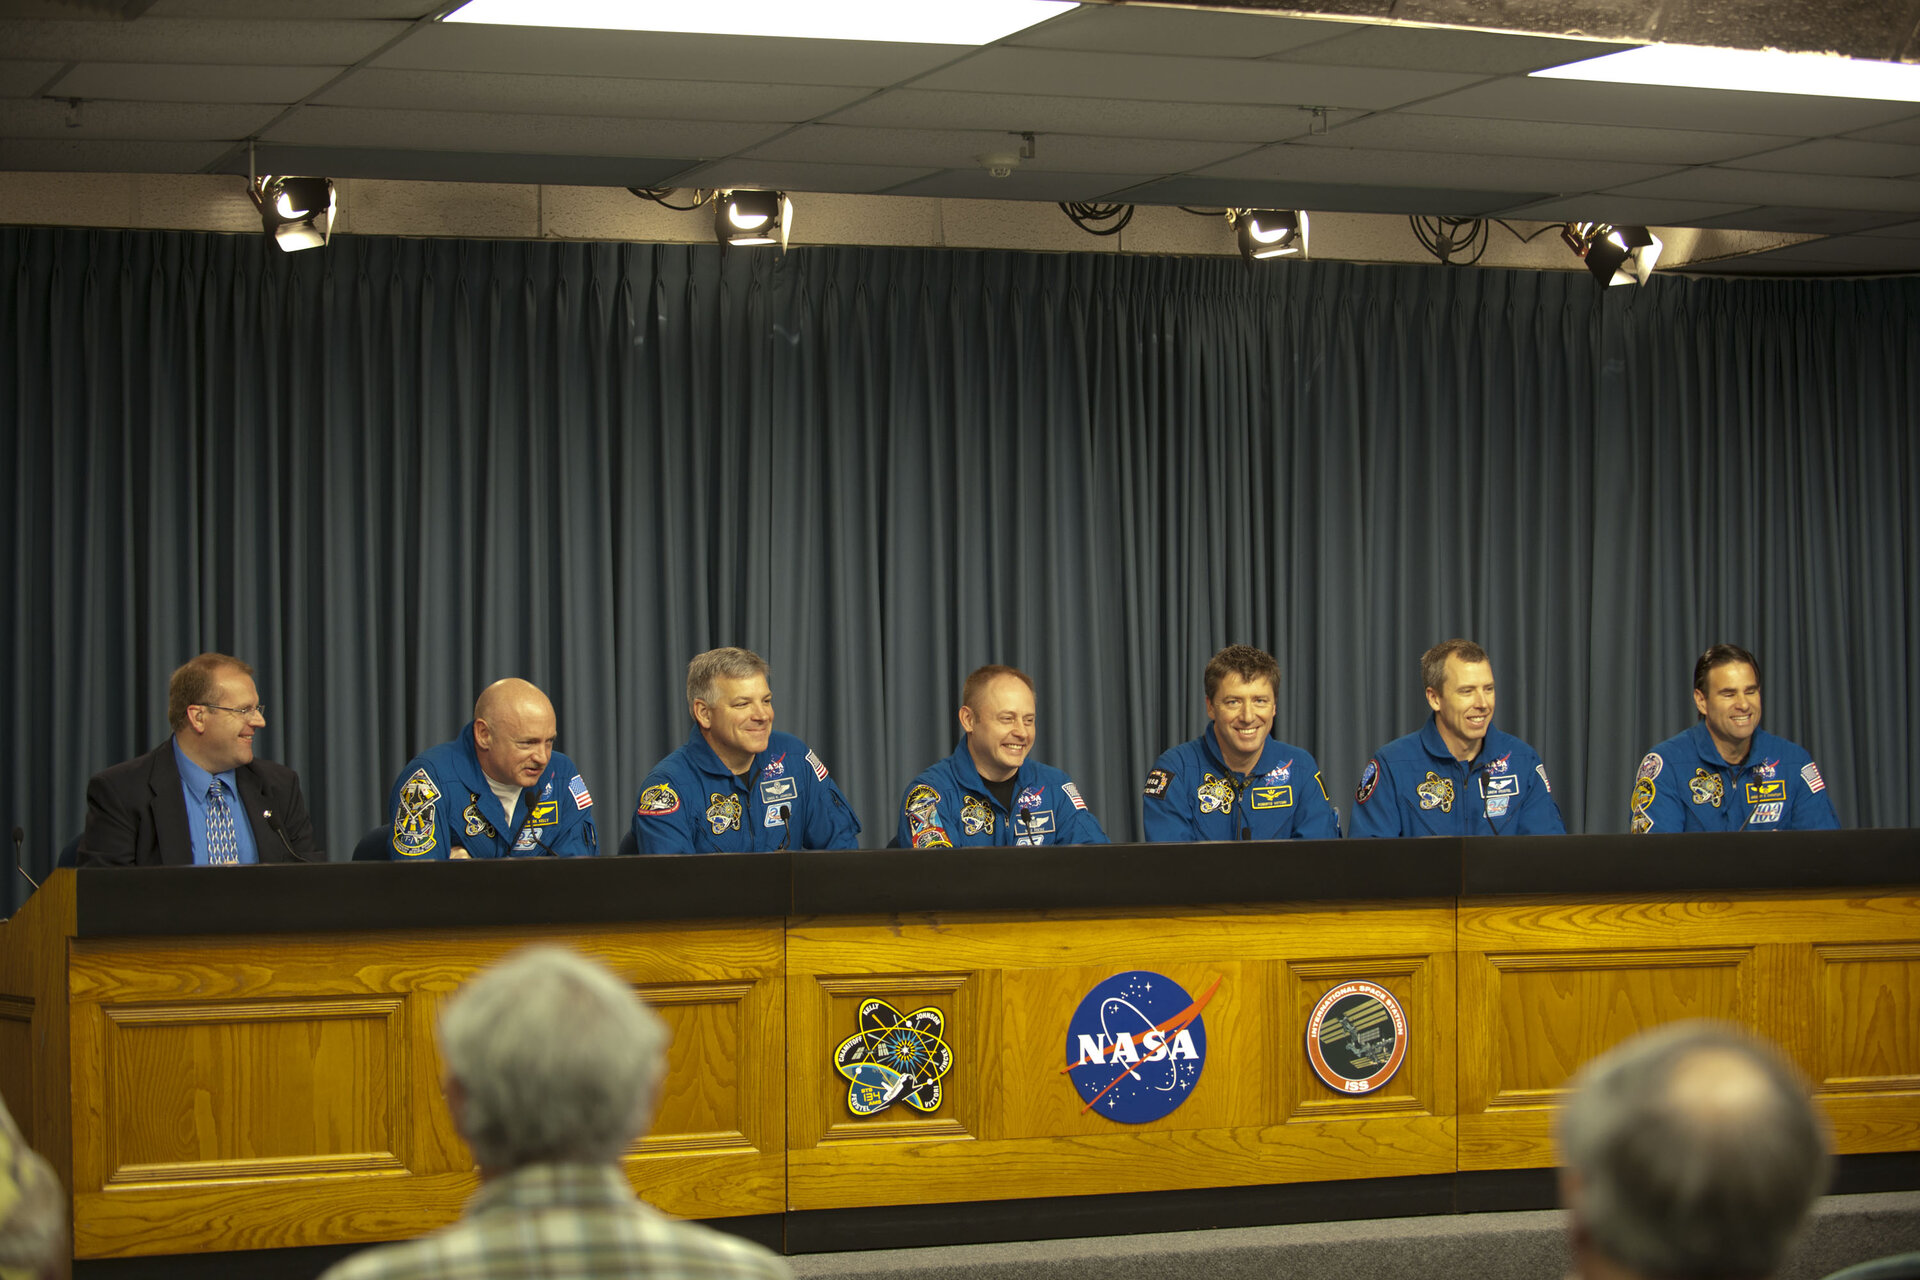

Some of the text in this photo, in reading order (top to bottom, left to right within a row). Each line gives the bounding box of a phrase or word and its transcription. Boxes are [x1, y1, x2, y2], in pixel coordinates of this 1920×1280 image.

[863, 1003, 880, 1016] KELLY
[1311, 985, 1403, 1038] INTERNATIONAL SPACE STATION
[915, 1013, 941, 1026] JOHNSON
[838, 1035, 863, 1062] CHAMITOFF
[1077, 1029, 1199, 1066] NASA
[1344, 1080, 1369, 1091] ISS
[851, 1093, 871, 1112] FEUSTEL
[863, 1091, 881, 1102] 134
[924, 1085, 939, 1108] VITTORI
